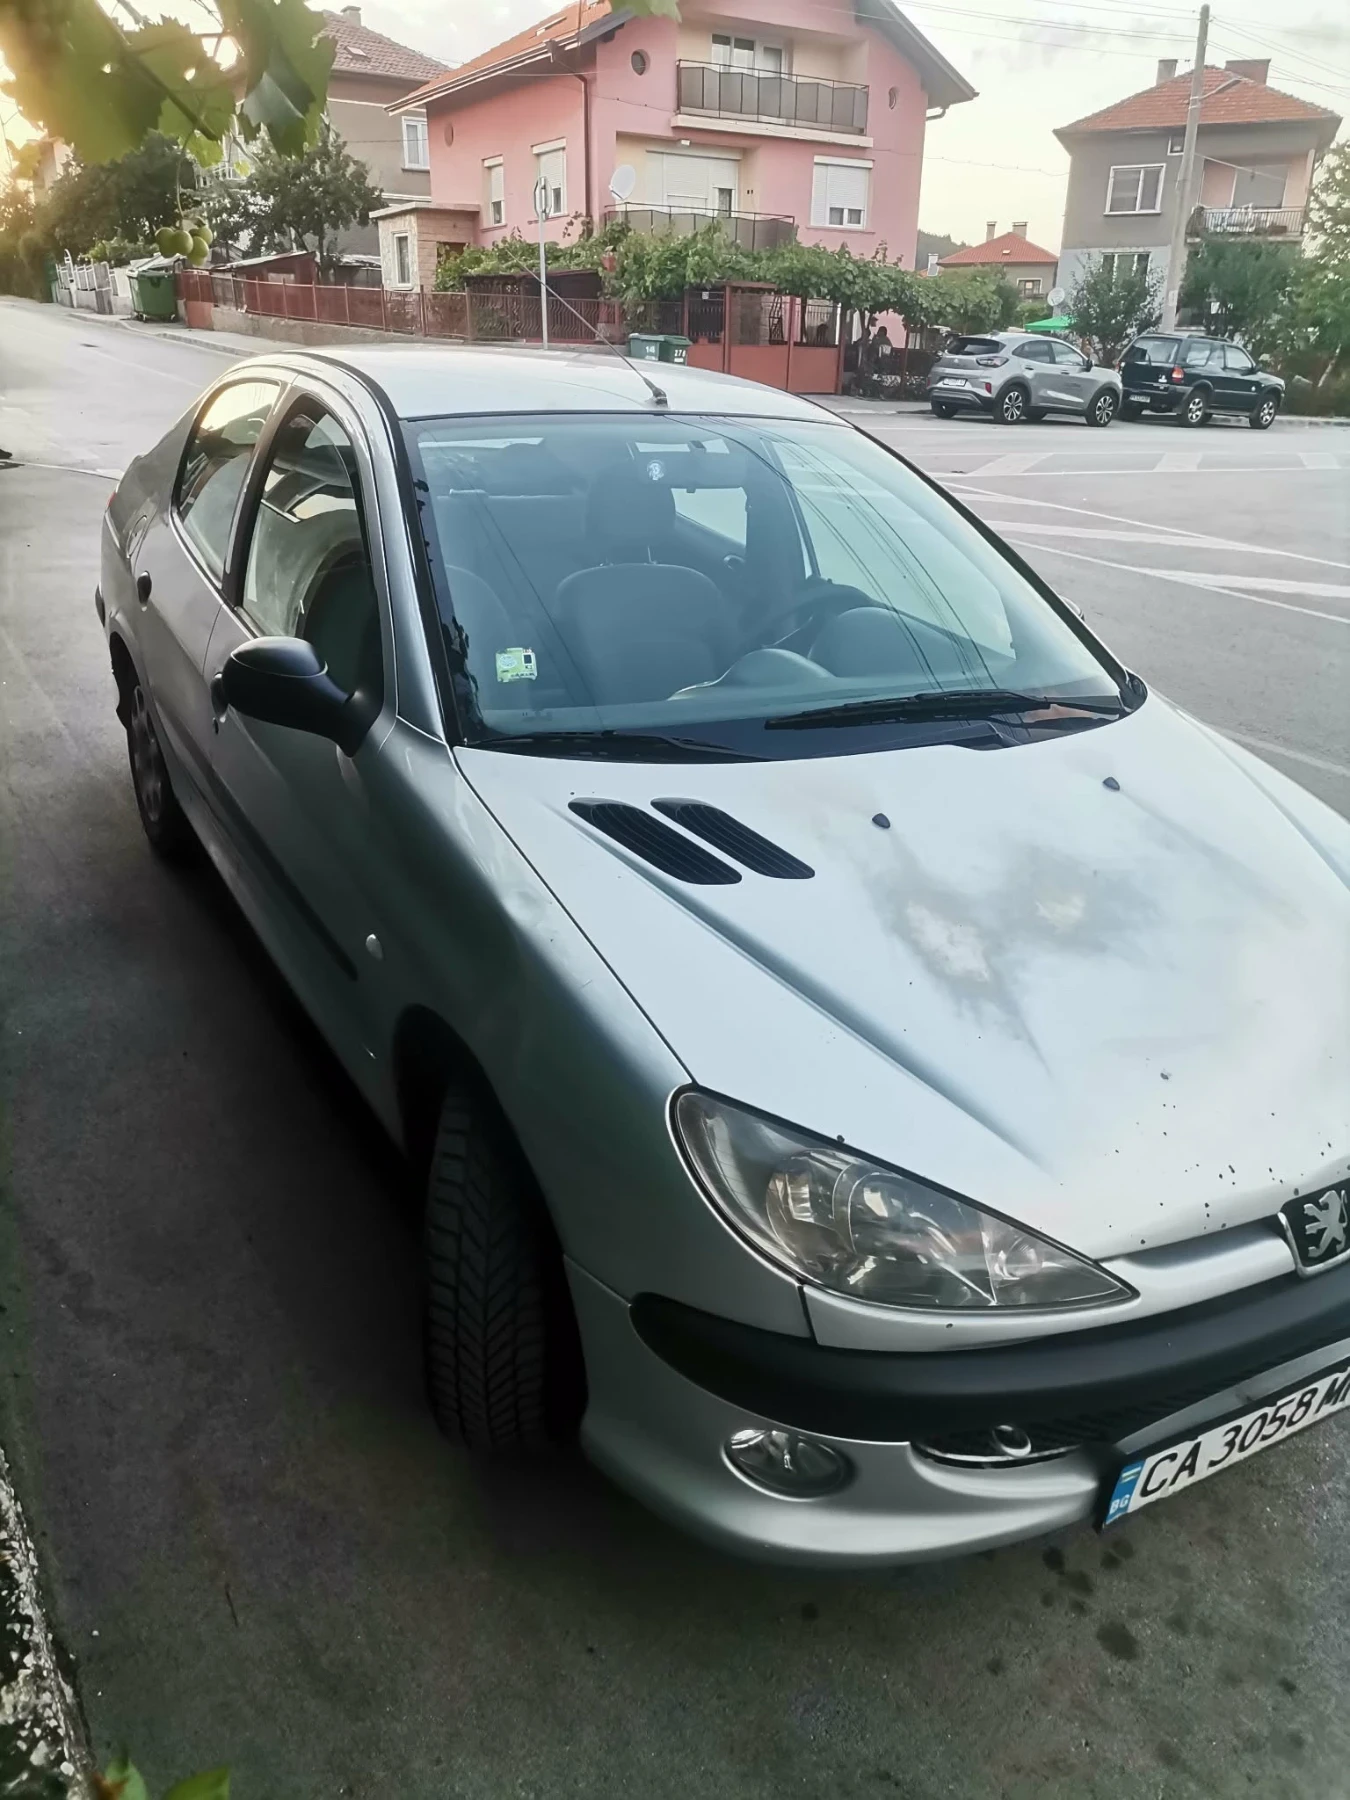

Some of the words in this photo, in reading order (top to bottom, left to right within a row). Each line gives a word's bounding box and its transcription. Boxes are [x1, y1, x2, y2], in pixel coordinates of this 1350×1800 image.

[1140, 1441, 1202, 1497] CA
[1208, 1387, 1319, 1468] 3058
[1109, 1494, 1130, 1515] BG
